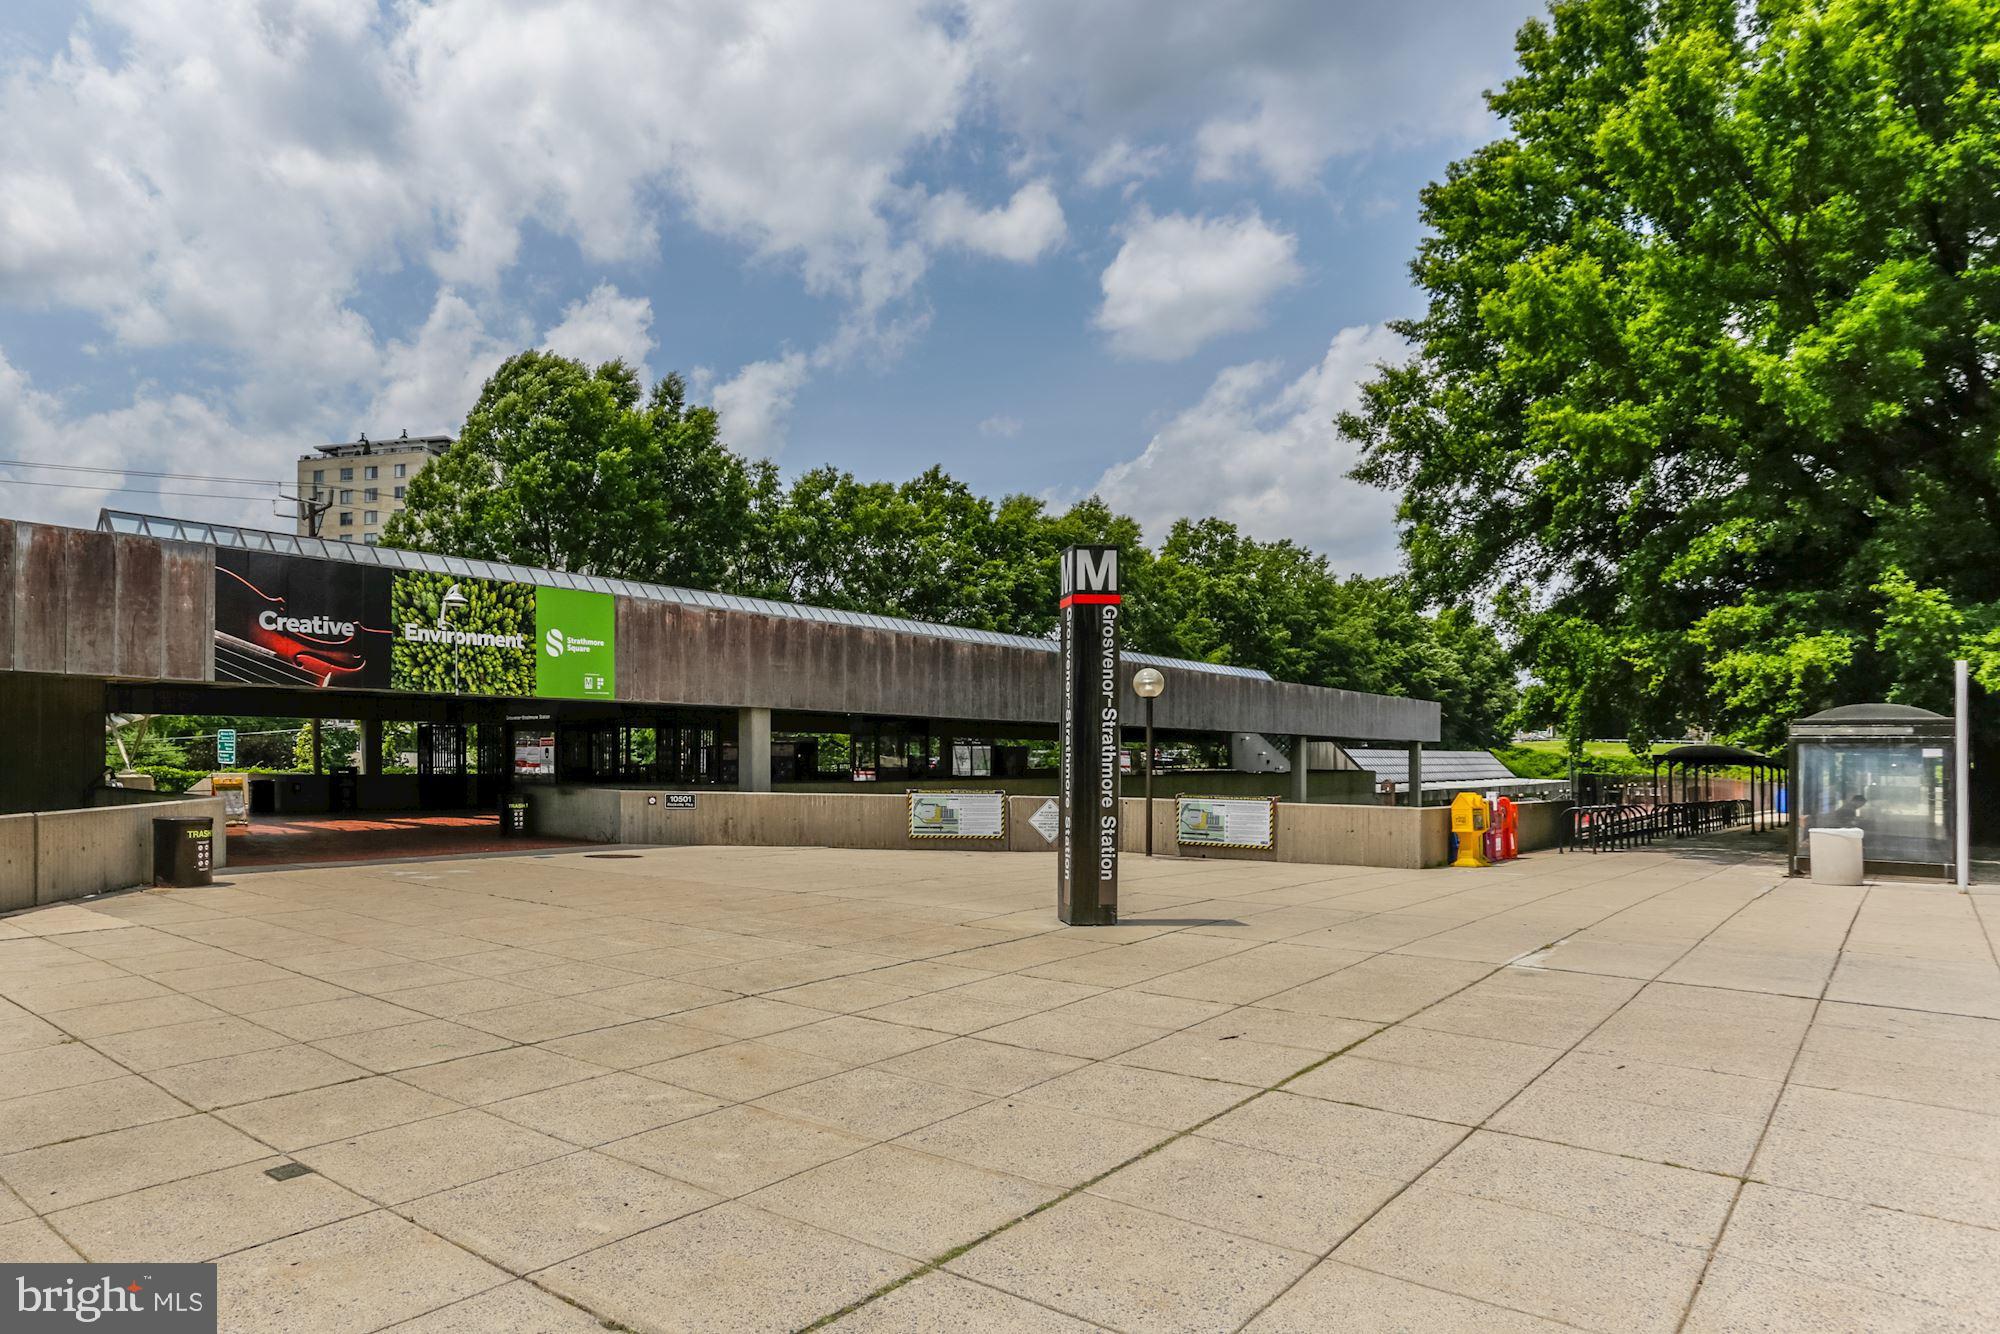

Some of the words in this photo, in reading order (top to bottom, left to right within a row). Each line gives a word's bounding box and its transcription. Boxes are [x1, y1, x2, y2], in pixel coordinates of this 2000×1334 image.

[1061, 551, 1073, 595] M
[1076, 550, 1117, 591] M
[258, 610, 355, 638] Creative
[404, 625, 525, 650] Environment
[566, 636, 604, 647] Strathmore
[566, 643, 591, 653] Square
[1101, 604, 1118, 808] Grosvenor-Strathmore
[1064, 815, 1072, 881] Station
[1101, 815, 1117, 881] Station
